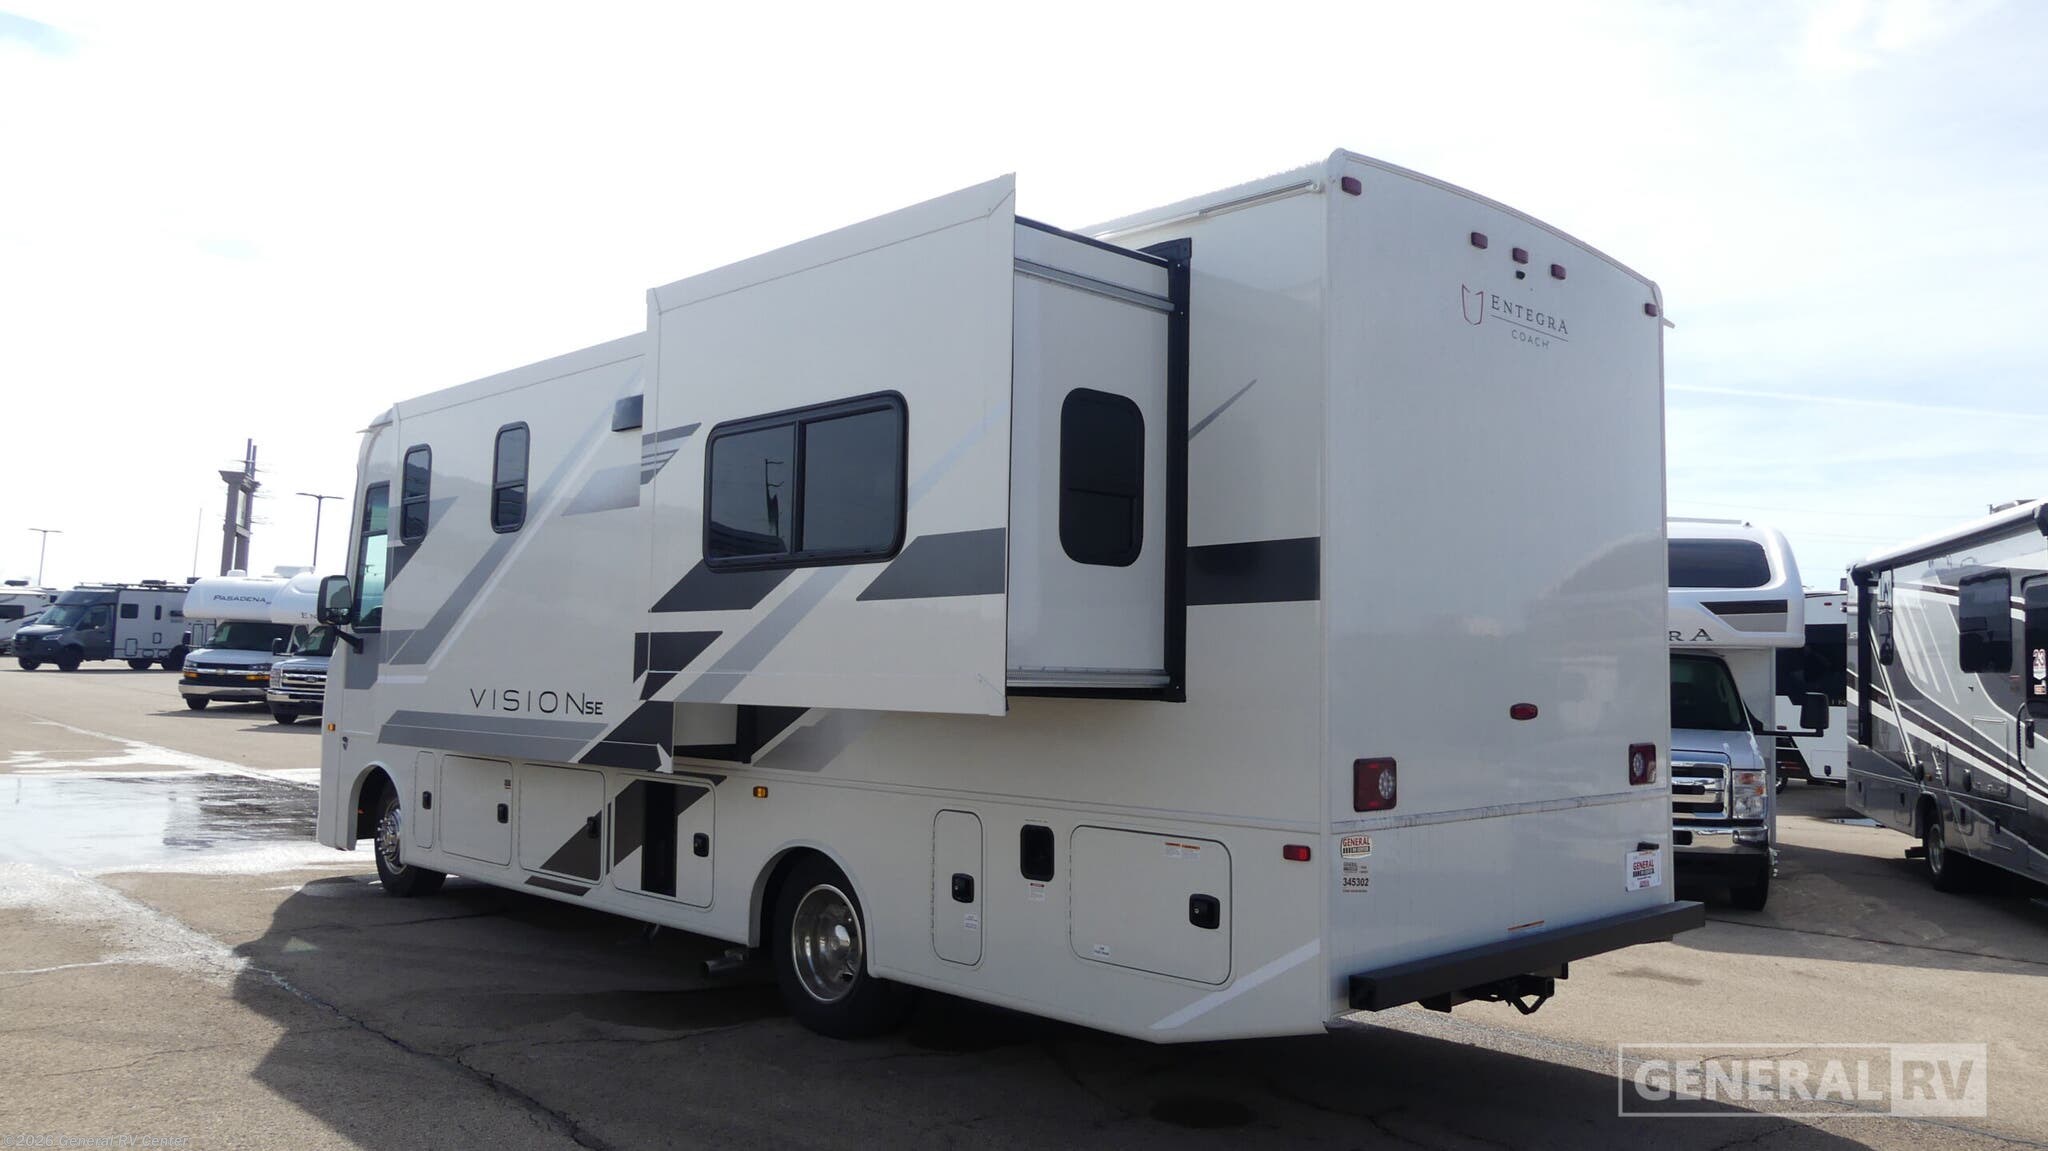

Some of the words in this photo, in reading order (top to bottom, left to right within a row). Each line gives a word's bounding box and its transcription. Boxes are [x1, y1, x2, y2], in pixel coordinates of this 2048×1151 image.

[1491, 294, 1568, 335] ENTEGRA
[1511, 328, 1549, 350] COACH
[213, 594, 266, 603] PASADENA
[1668, 628, 1712, 641] RA
[470, 687, 585, 715] VISION
[585, 701, 603, 715] SE
[1343, 836, 1370, 847] GENERAL
[1632, 859, 1654, 871] GENERAL
[1342, 877, 1369, 887] 345302
